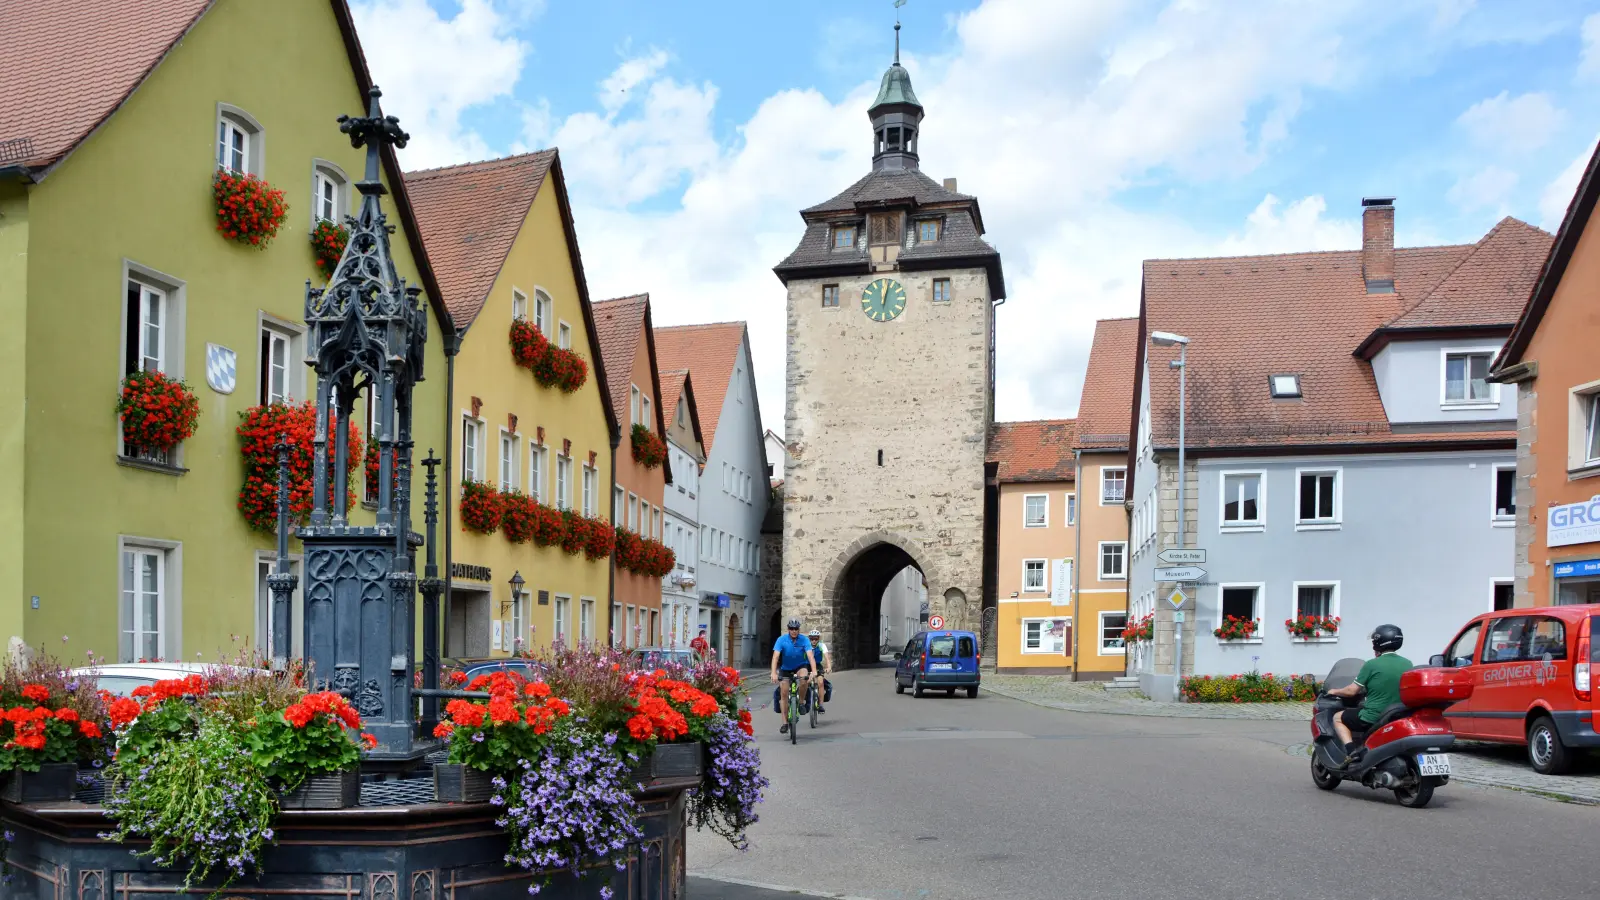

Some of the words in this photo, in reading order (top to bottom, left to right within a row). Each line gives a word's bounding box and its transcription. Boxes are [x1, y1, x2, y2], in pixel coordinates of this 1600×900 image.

[1483, 663, 1532, 682] GRÖNER
[1426, 755, 1438, 765] AN
[1435, 764, 1450, 774] 352
